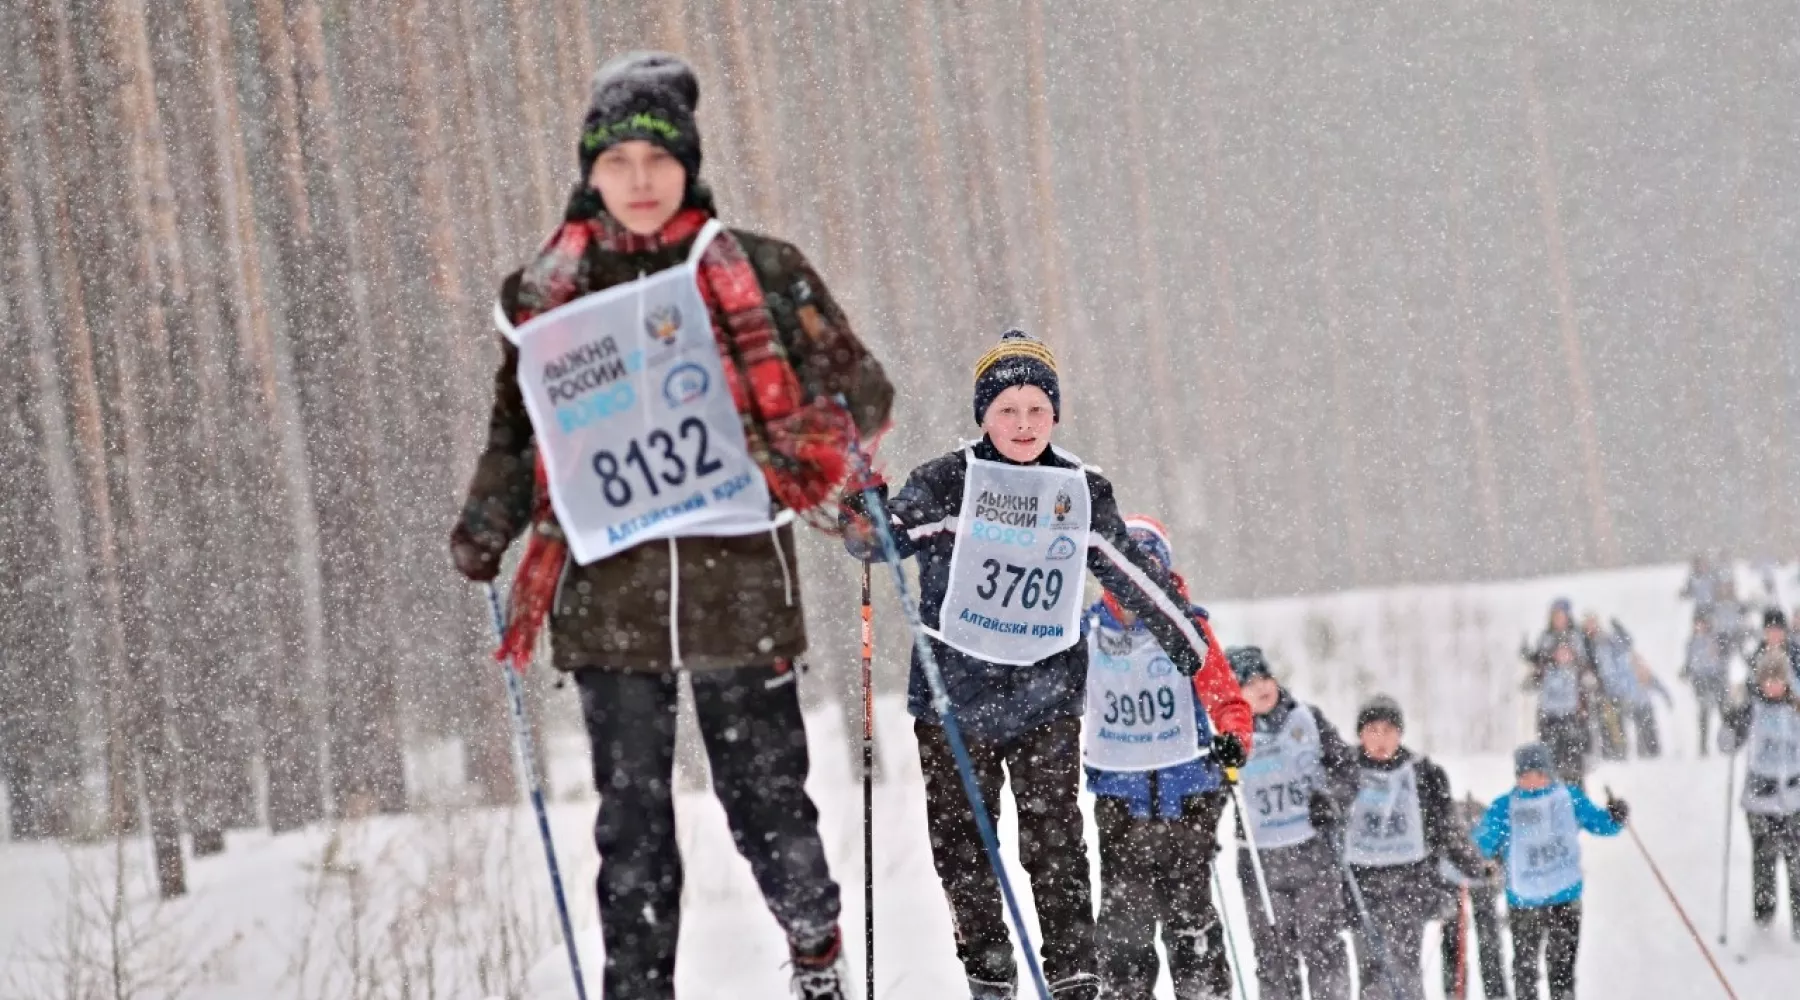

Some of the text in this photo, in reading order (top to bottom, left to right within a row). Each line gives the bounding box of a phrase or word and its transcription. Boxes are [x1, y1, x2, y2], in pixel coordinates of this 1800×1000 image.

[548, 360, 627, 406] РОССИИ
[592, 416, 724, 507] 8132
[607, 493, 707, 545] Алтайский
[975, 490, 1039, 512] ЛЫЖНЯ
[975, 506, 1038, 529] РОССИИ
[972, 521, 1036, 547] 2020
[976, 558, 1063, 611] 3769
[1031, 623, 1064, 639] край
[1103, 685, 1175, 726] 3909
